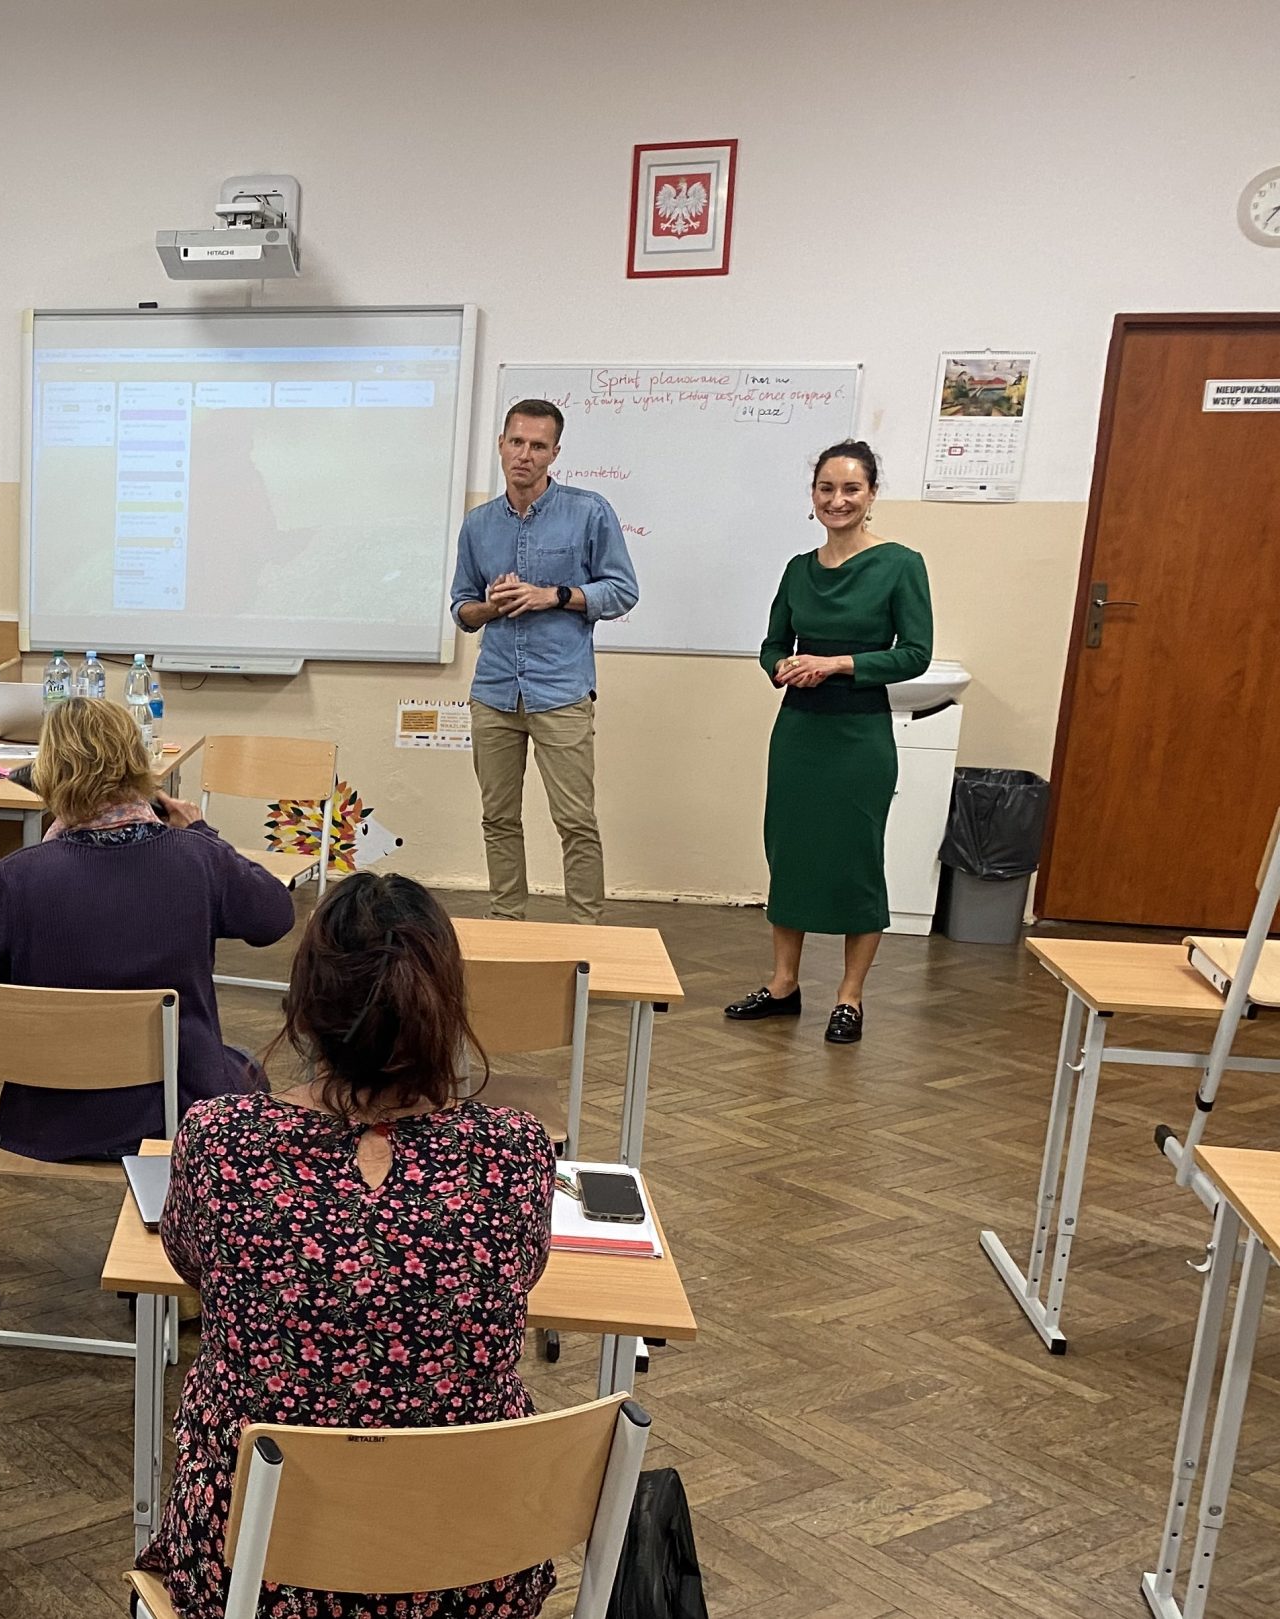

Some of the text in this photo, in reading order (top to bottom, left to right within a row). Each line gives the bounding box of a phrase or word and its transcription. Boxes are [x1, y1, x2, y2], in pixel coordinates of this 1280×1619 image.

[596, 370, 641, 396] Sprint
[1212, 397, 1280, 406] WSTĘP WZBRON
